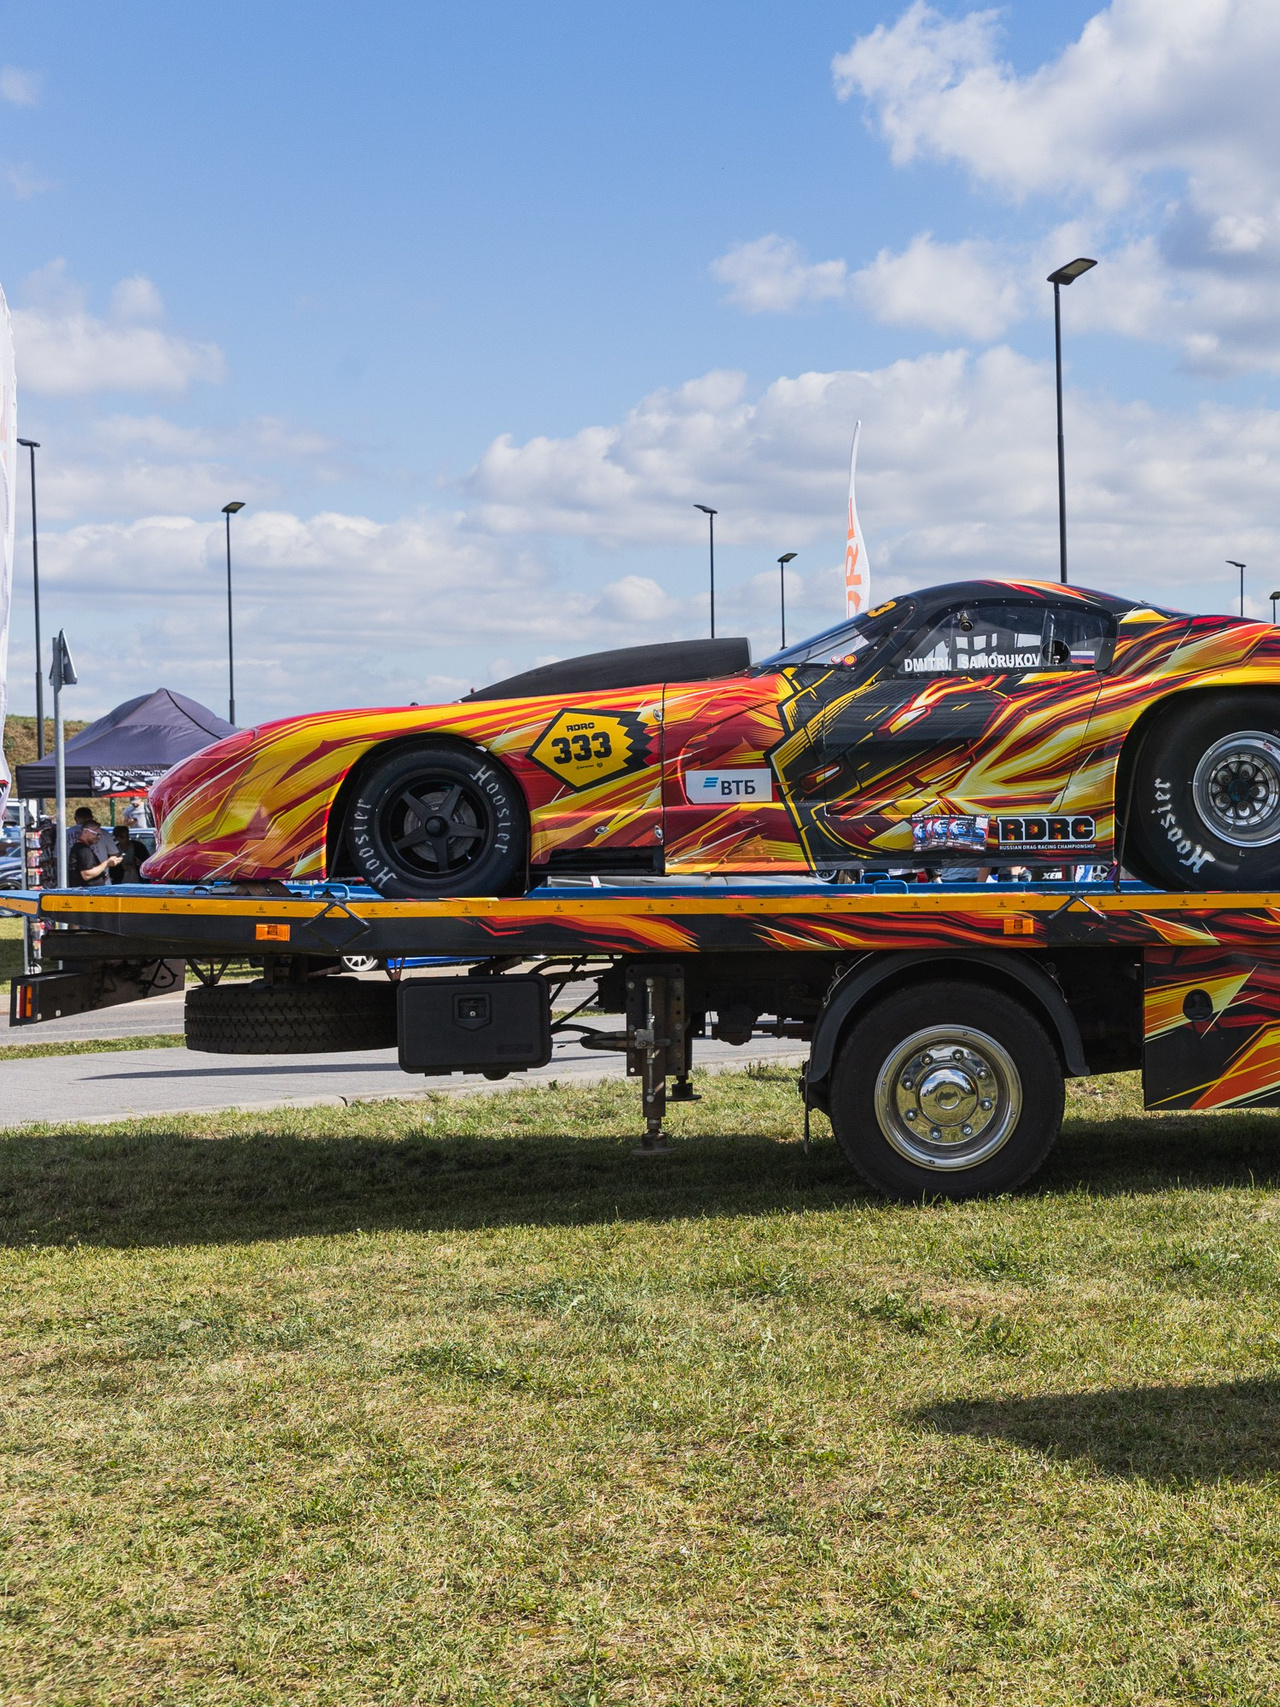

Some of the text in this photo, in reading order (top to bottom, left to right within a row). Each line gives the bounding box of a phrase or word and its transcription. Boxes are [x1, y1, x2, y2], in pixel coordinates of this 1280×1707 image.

[961, 653, 1041, 669] SAMORUKOV
[565, 722, 596, 733] RDRC
[551, 731, 613, 765] 333
[721, 780, 756, 796] ВТБ
[469, 764, 512, 854] Hoosier
[998, 817, 1095, 841] RDRC
[1151, 777, 1216, 874] Hoosier
[351, 798, 399, 889] Hoosier
